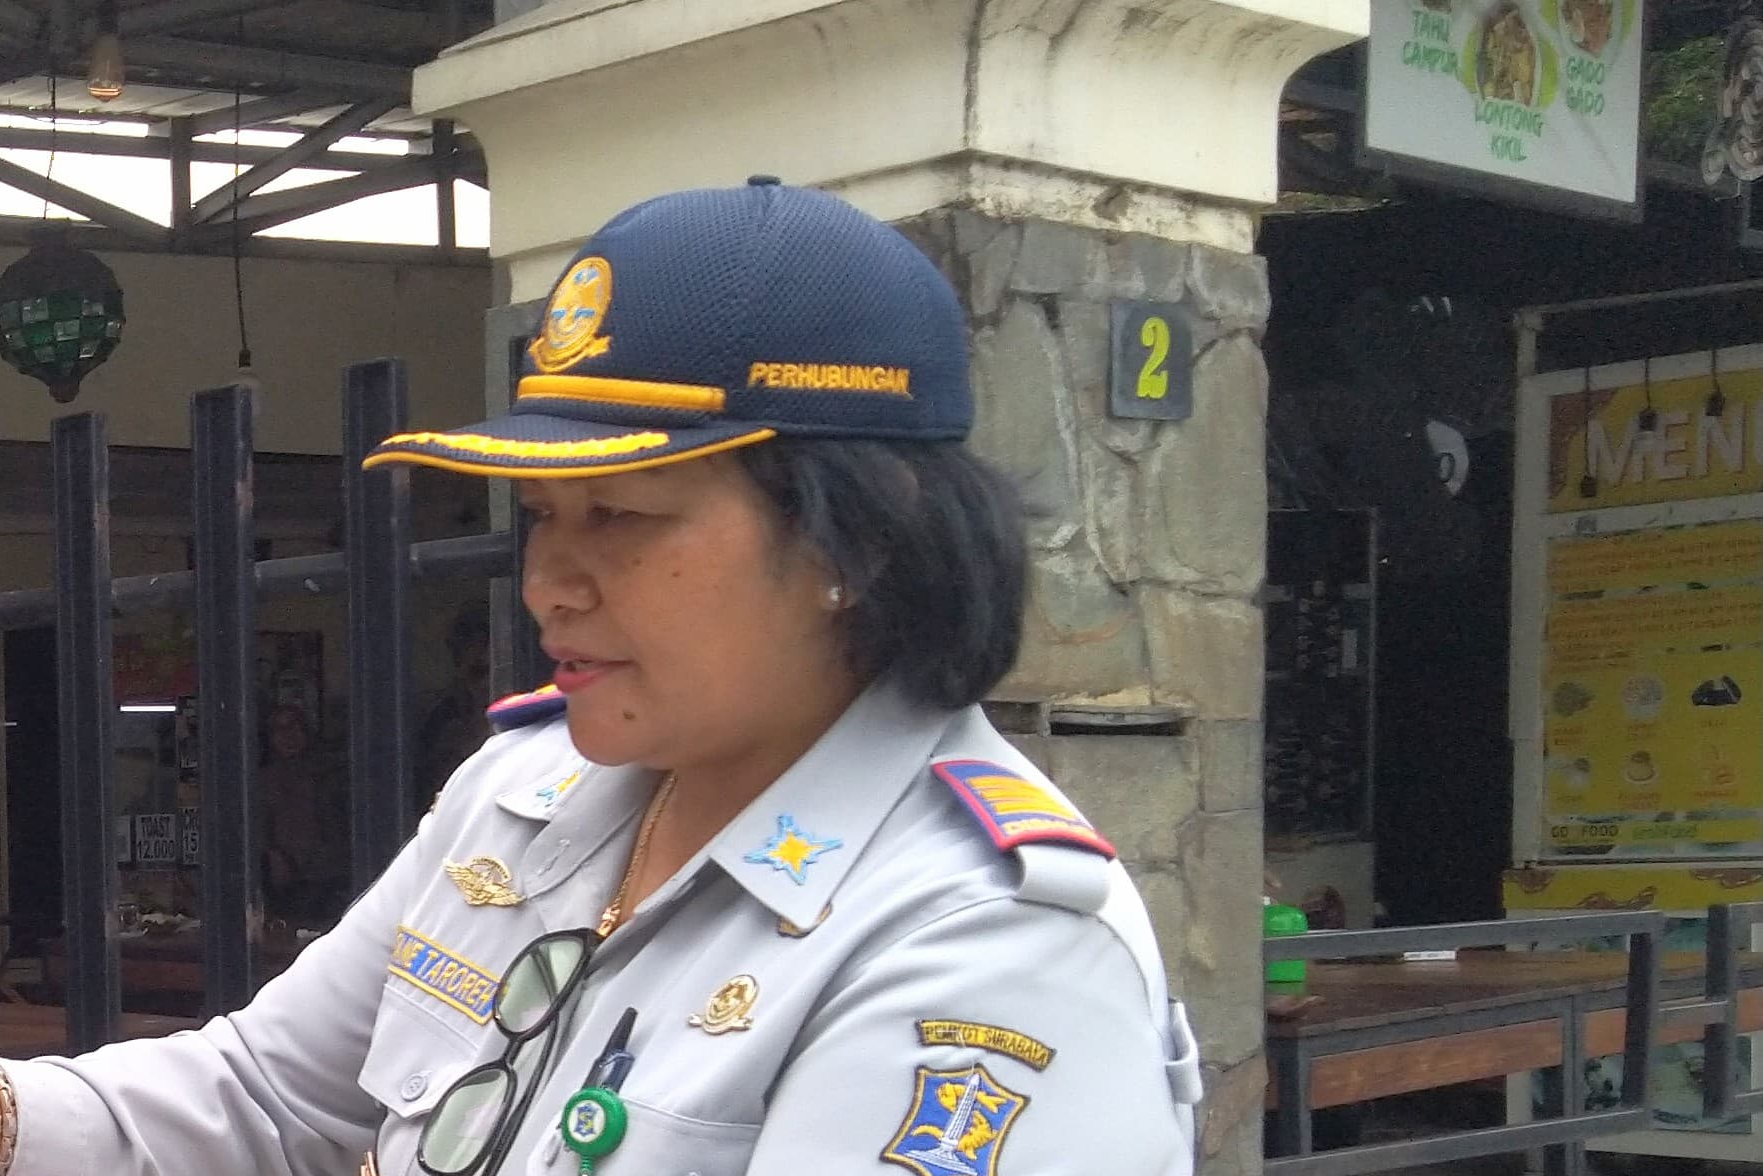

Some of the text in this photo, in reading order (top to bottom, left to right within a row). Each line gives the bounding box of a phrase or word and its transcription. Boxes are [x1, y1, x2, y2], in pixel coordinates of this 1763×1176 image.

[1566, 56, 1605, 85] GADO
[1475, 102, 1543, 137] LONTONG
[1136, 317, 1170, 399] 2
[747, 361, 911, 394] PERHUBUNGAN
